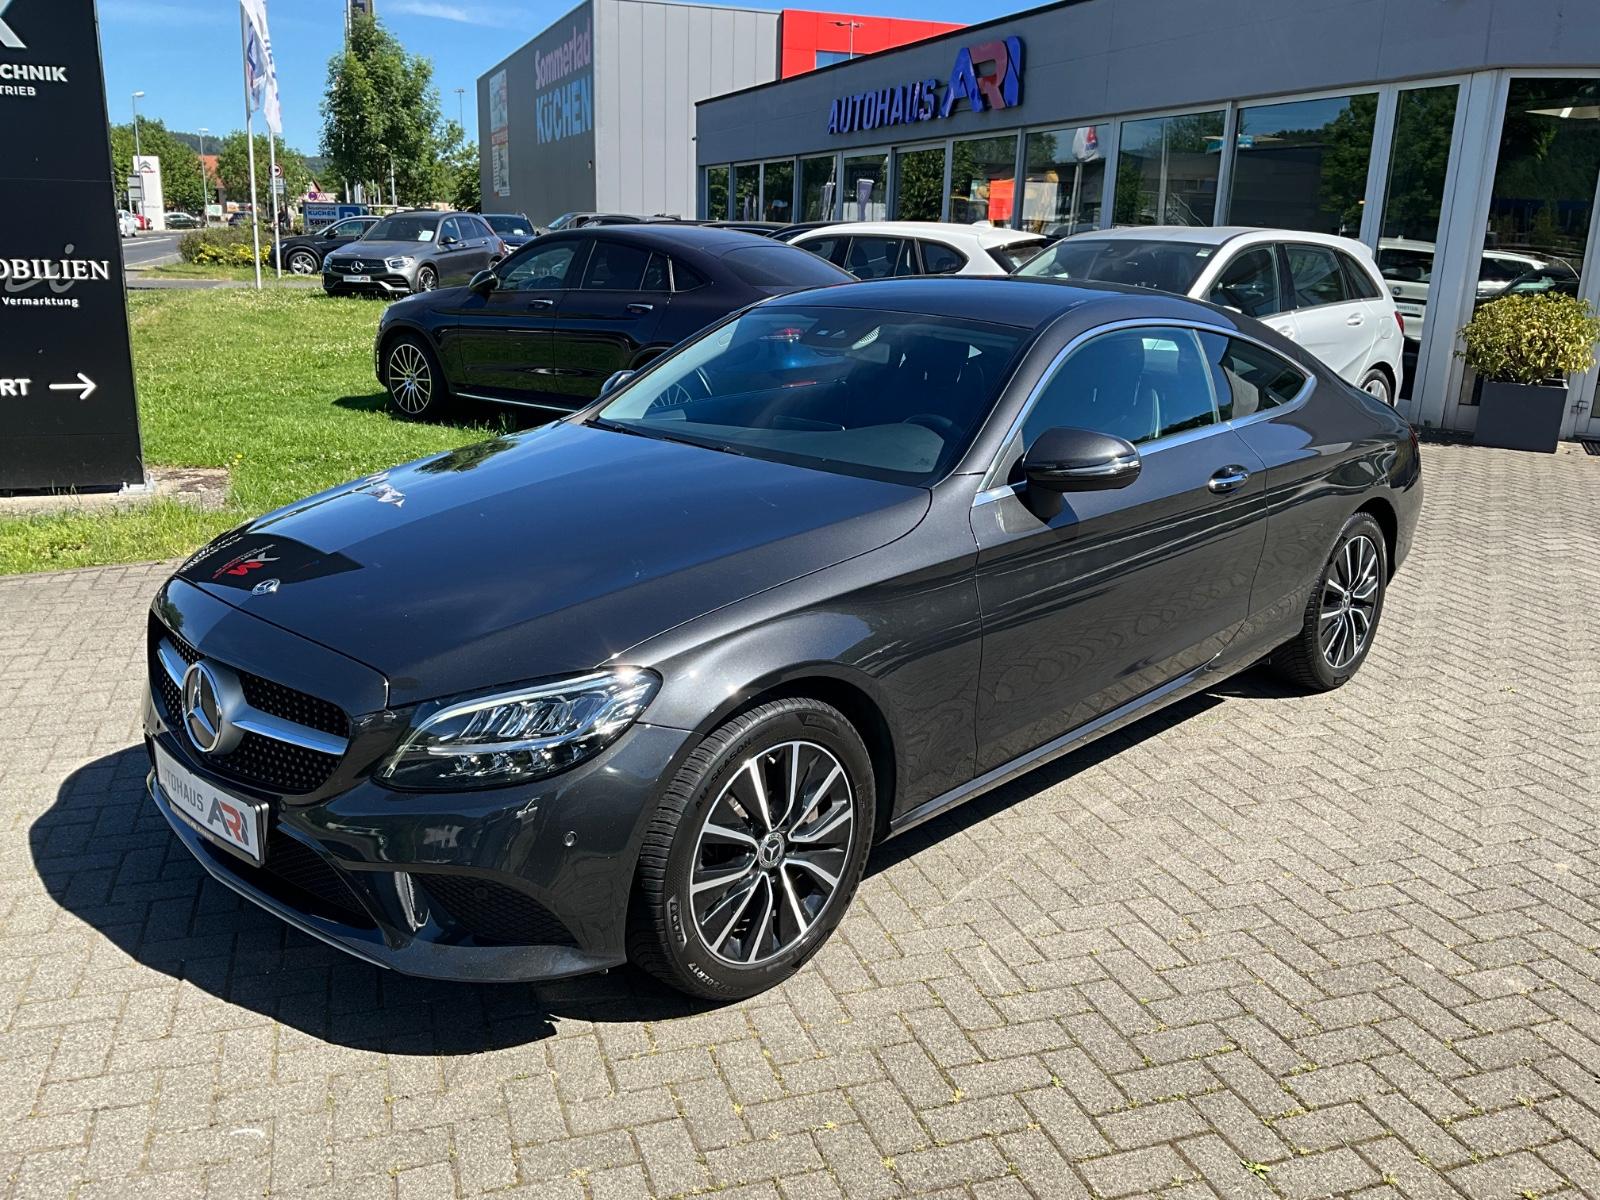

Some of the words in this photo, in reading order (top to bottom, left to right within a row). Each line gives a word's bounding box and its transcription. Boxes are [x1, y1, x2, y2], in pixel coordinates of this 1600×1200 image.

[535, 17, 592, 90] Sommerlad
[828, 78, 938, 134] AUTOHAUS
[938, 35, 1023, 119] ARI
[2, 296, 79, 308] Vermarktung
[207, 797, 250, 847] ARI
